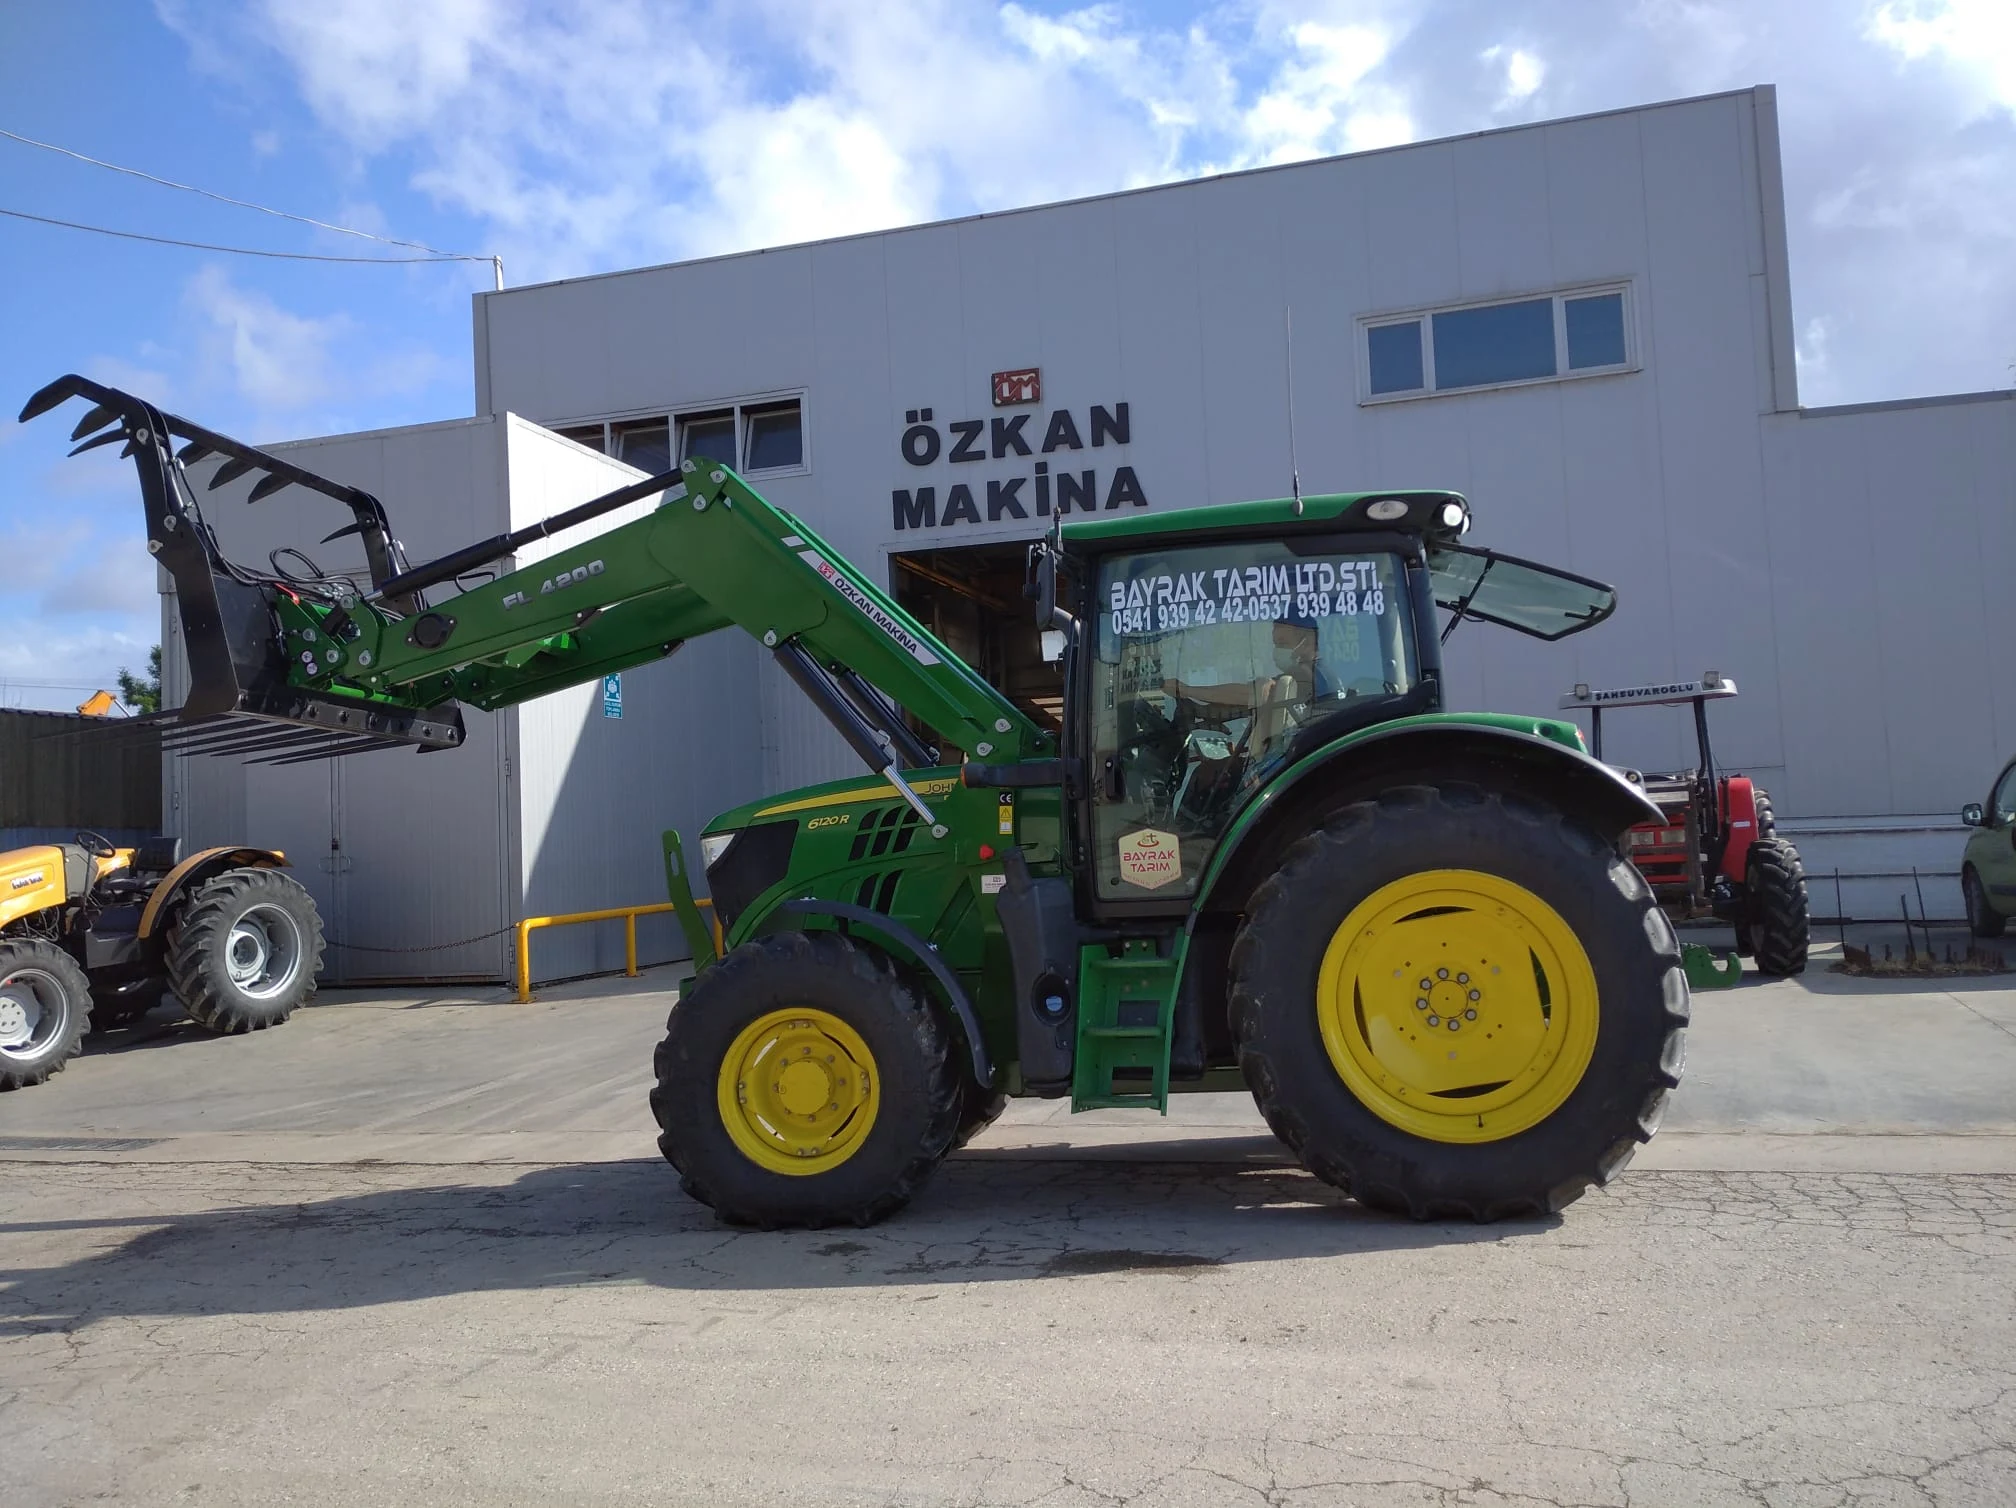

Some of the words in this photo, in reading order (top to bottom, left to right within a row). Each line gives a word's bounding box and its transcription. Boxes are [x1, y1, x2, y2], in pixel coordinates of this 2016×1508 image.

[901, 402, 1130, 466] ÖZKAN
[892, 462, 1148, 530] MAKİNA
[540, 560, 605, 595] 4200
[1111, 571, 1208, 610] BAYRAK
[1213, 564, 1291, 598] TARIM
[834, 577, 875, 615] ÖZKAN
[873, 611, 918, 654] MAKİNA
[1112, 607, 1152, 635] 0541
[1158, 603, 1190, 629] 939
[1194, 600, 1217, 625] 42
[1297, 592, 1330, 618] 939
[1335, 591, 1358, 616] 48
[1363, 590, 1385, 615] 48
[1123, 850, 1175, 861] BAYRAK
[1131, 862, 1171, 872] TARIM
